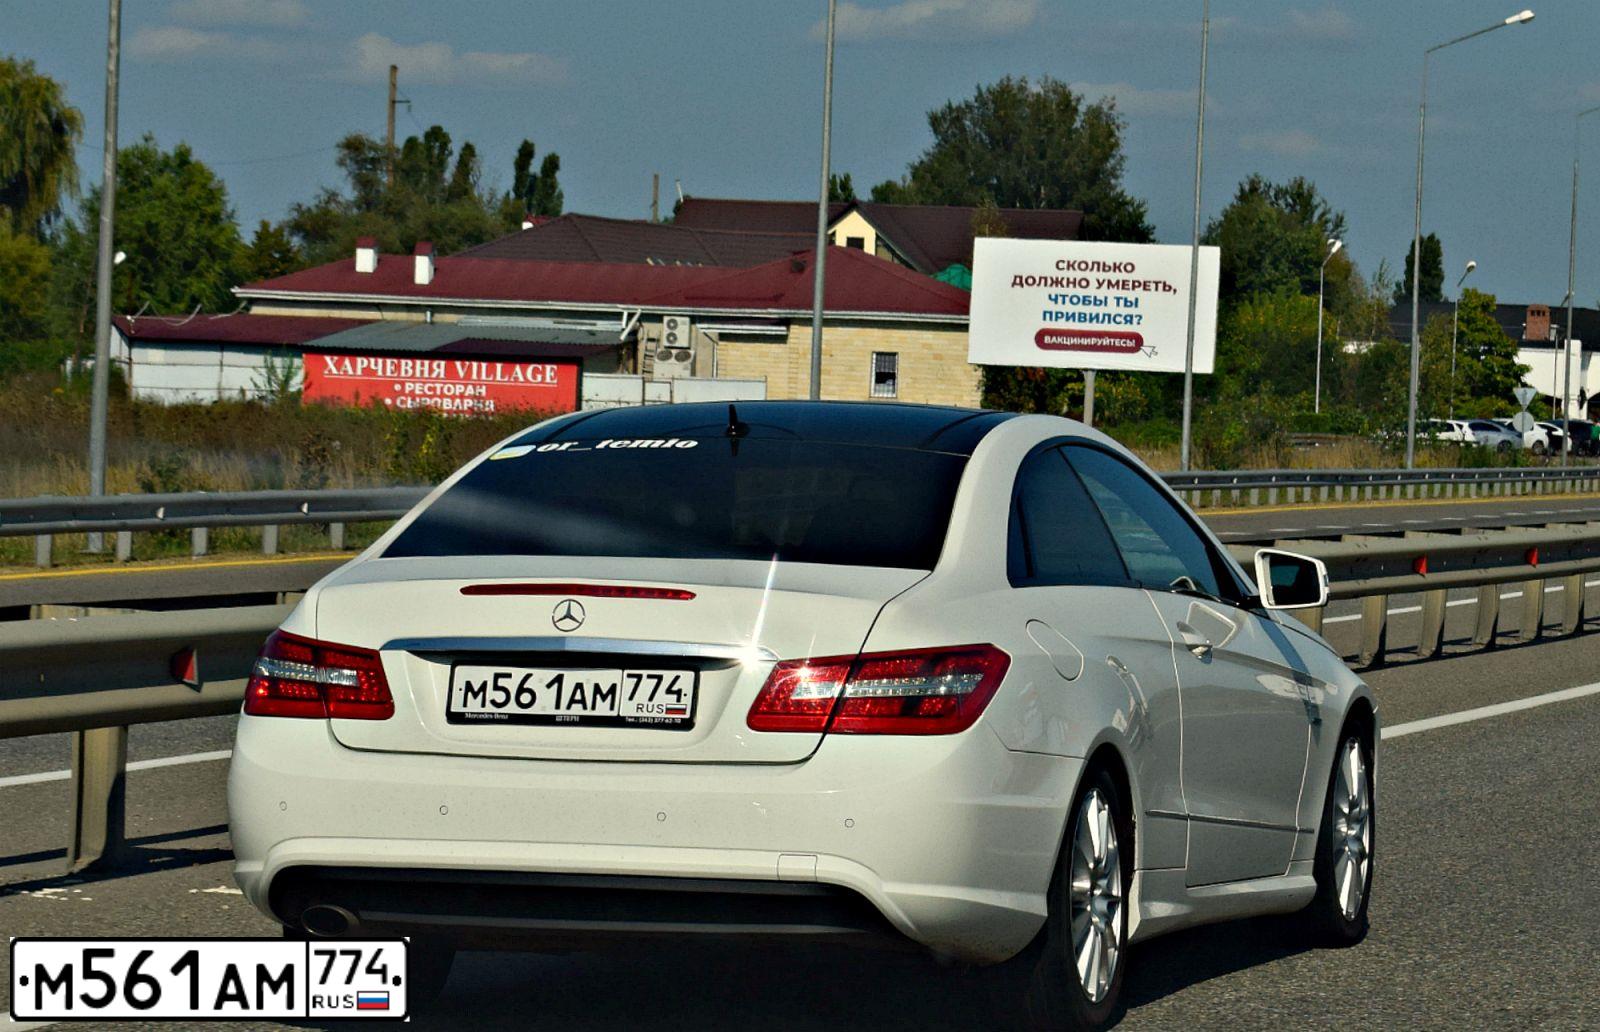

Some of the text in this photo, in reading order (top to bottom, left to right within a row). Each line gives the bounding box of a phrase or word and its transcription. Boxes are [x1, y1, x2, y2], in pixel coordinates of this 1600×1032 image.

[1055, 259, 1136, 273] СКОЛЬКО
[1011, 275, 1177, 295] ДОЛЖНО УМЕРЕТЬ,
[1048, 293, 1139, 308] ЧТОБЫ ТЫ
[1042, 310, 1143, 325] ПРИВИЛСЯ?
[323, 355, 558, 384] ХАРЧЕВНЯ VILLAGE
[404, 382, 487, 397] РЕСТОРАН
[462, 672, 683, 711] М561АМ 774
[636, 703, 665, 714] RUS
